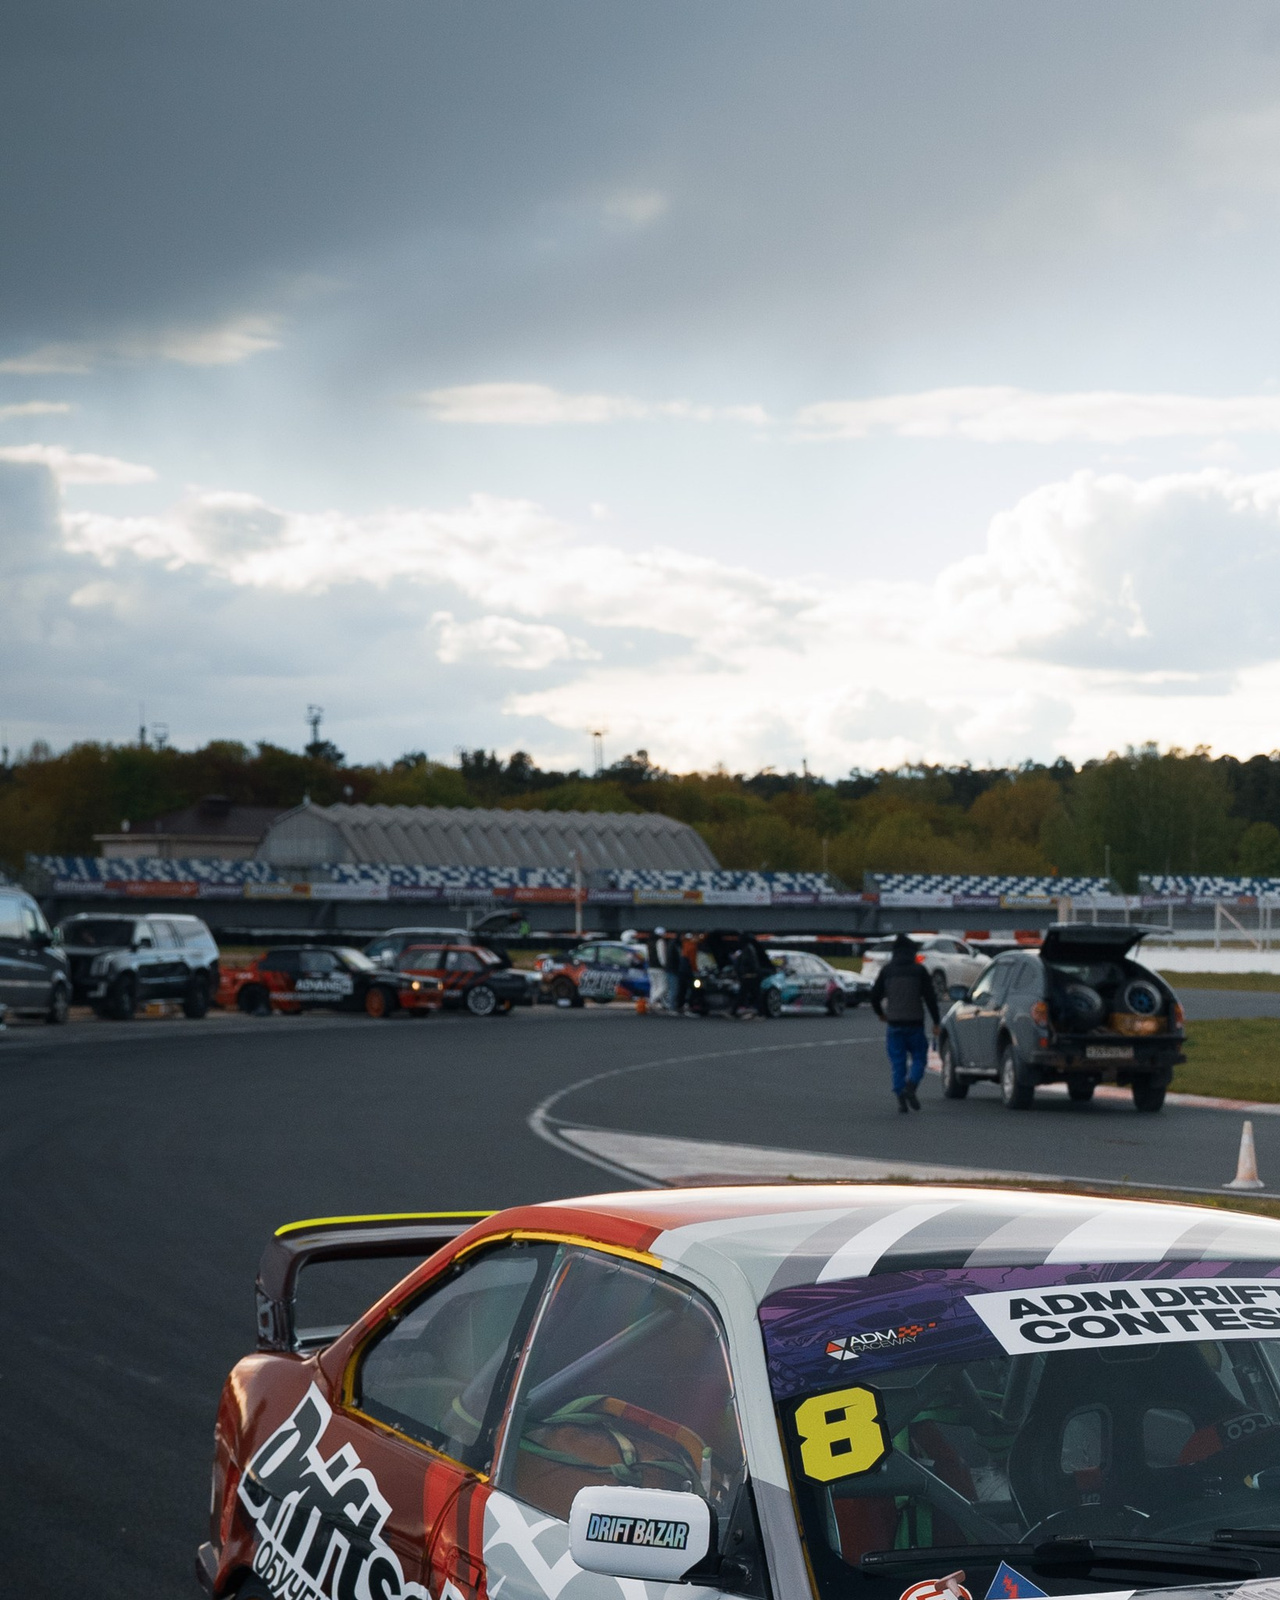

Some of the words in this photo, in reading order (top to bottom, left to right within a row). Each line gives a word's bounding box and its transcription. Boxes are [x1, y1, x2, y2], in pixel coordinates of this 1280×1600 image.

[1009, 1289, 1137, 1320] ADM
[849, 1328, 898, 1347] ADM
[850, 1335, 918, 1354] RACEWAY
[795, 1386, 885, 1483] 8
[587, 1514, 634, 1543] DRIFT
[632, 1519, 688, 1549] BAZAR
